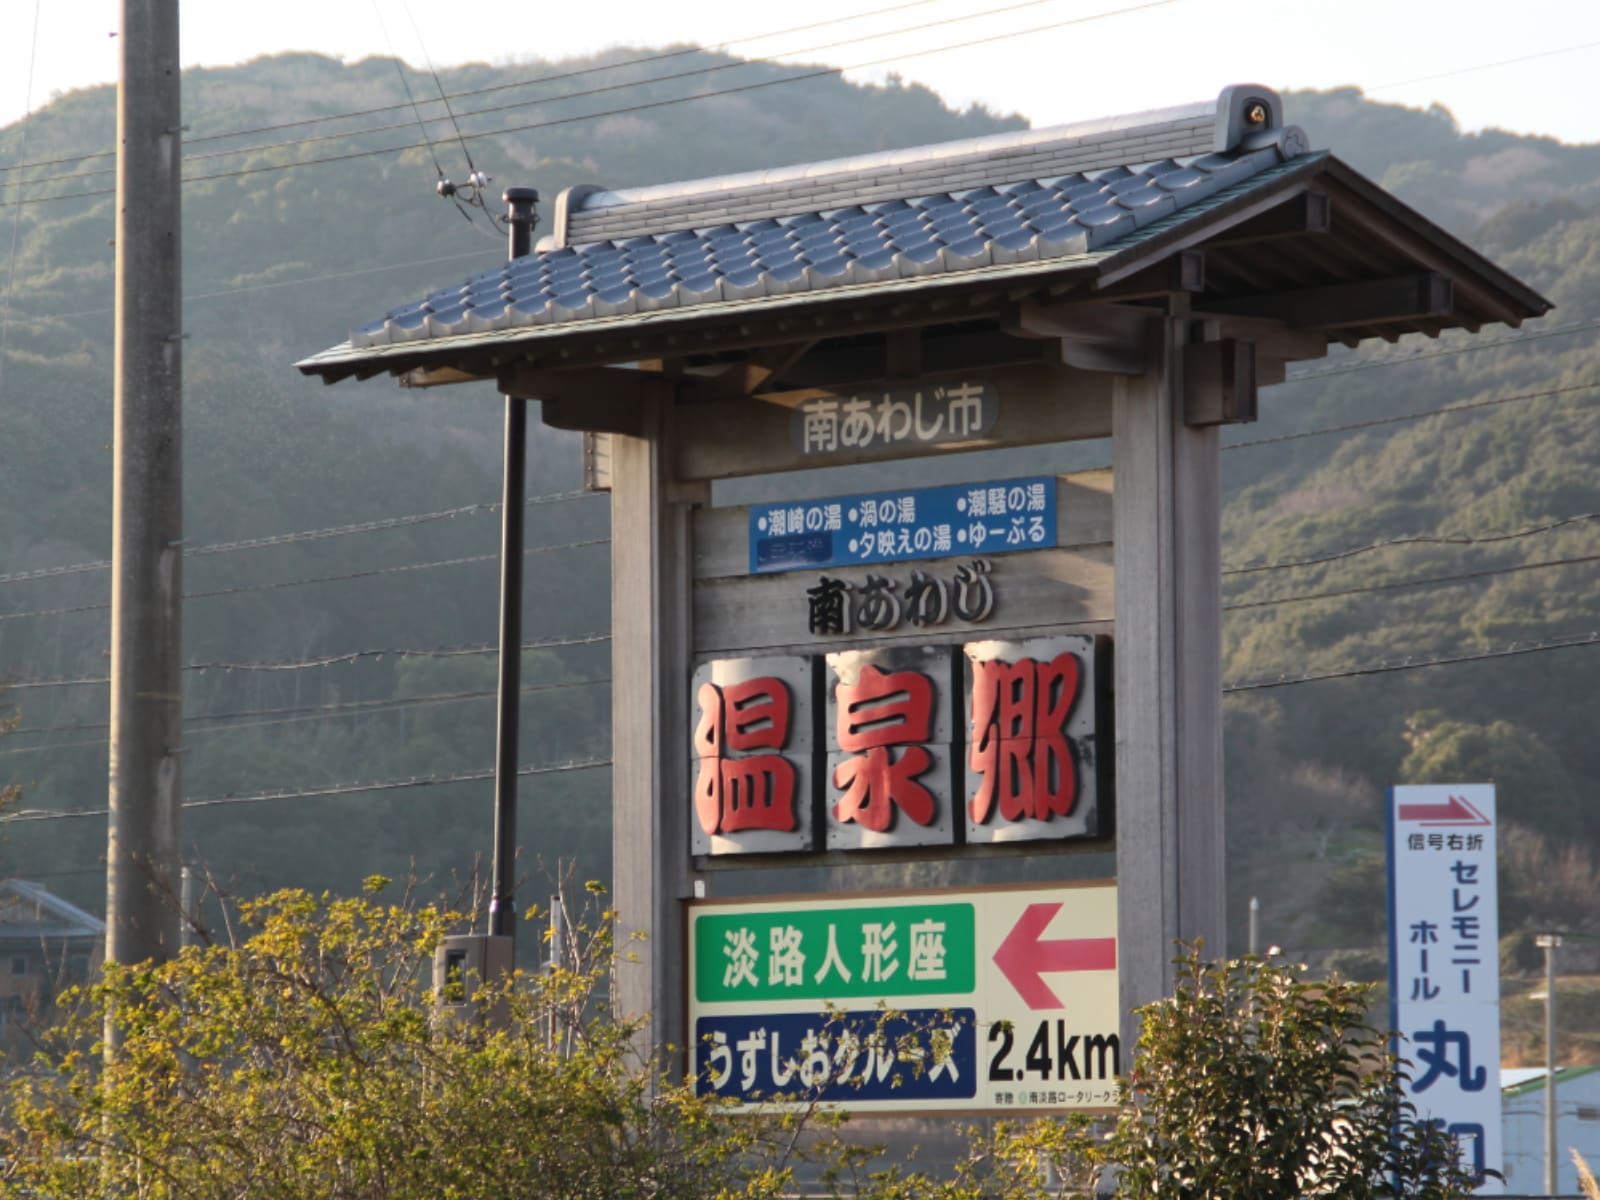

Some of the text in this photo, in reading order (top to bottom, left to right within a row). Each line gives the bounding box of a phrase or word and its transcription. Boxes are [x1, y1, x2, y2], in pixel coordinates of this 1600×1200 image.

[802, 382, 985, 454] 南あわじ市
[859, 524, 952, 559] 夕映えの湯
[806, 558, 993, 635] 南あわじ
[694, 652, 1079, 835] 温泉郷
[1407, 833, 1484, 851] 信号右折
[722, 918, 947, 988] 淡路人形座
[988, 1018, 1120, 1081] 2.4km
